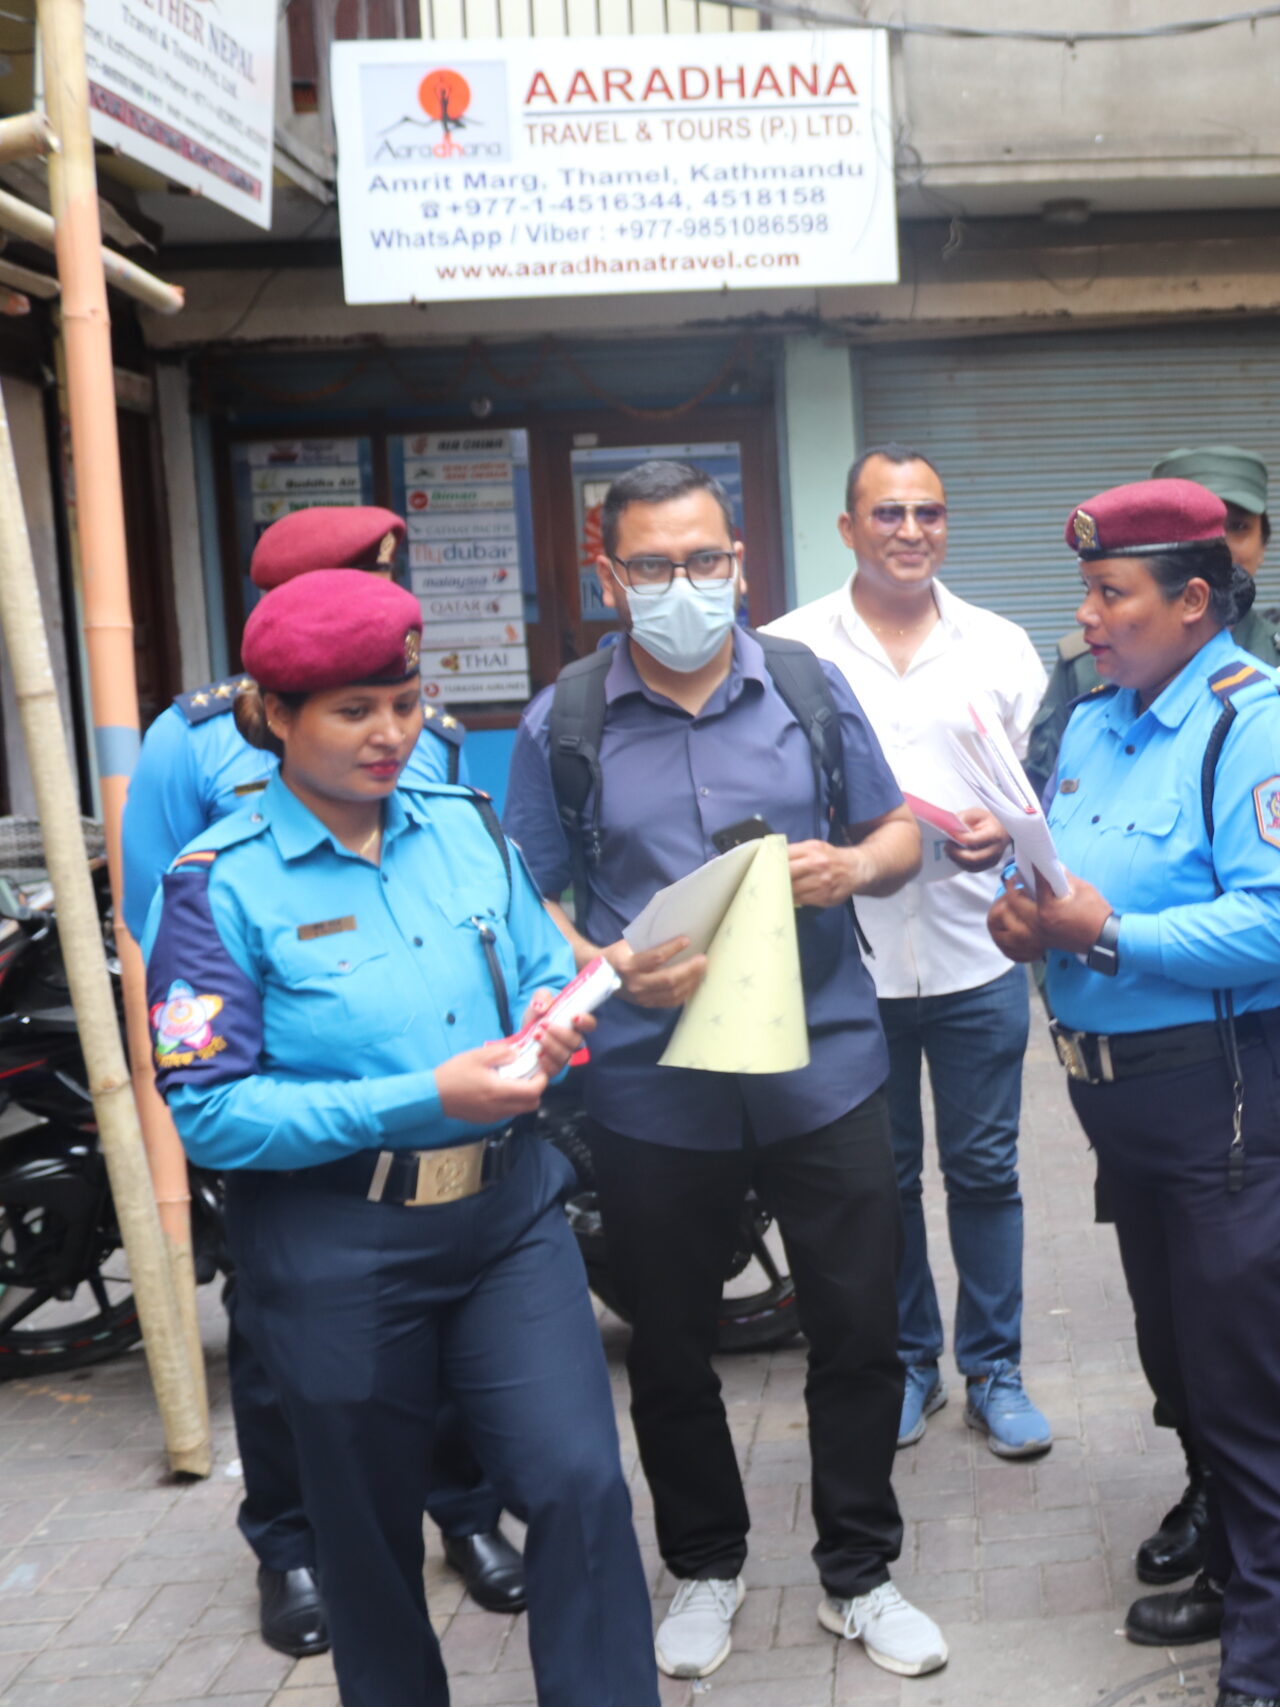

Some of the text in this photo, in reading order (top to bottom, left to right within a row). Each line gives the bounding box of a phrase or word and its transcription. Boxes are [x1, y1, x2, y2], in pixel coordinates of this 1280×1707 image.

[208, 22, 256, 84] NEPAL
[524, 62, 857, 105] AARADHANA
[524, 114, 860, 145] TRAVEL & TOURS (P.) LTD.
[374, 131, 502, 162] Aaradhana
[368, 173, 452, 194] Amrit
[557, 165, 678, 186] Thamel,
[690, 160, 864, 182] Kathmandu
[703, 186, 826, 208] 4518158
[370, 227, 502, 251] WhatsApp
[510, 223, 518, 245] /
[526, 222, 590, 244] Viber
[616, 213, 829, 240] +977-9851086598
[436, 250, 800, 280] www.aaradhanatravel.com
[464, 653, 508, 668] THAI
